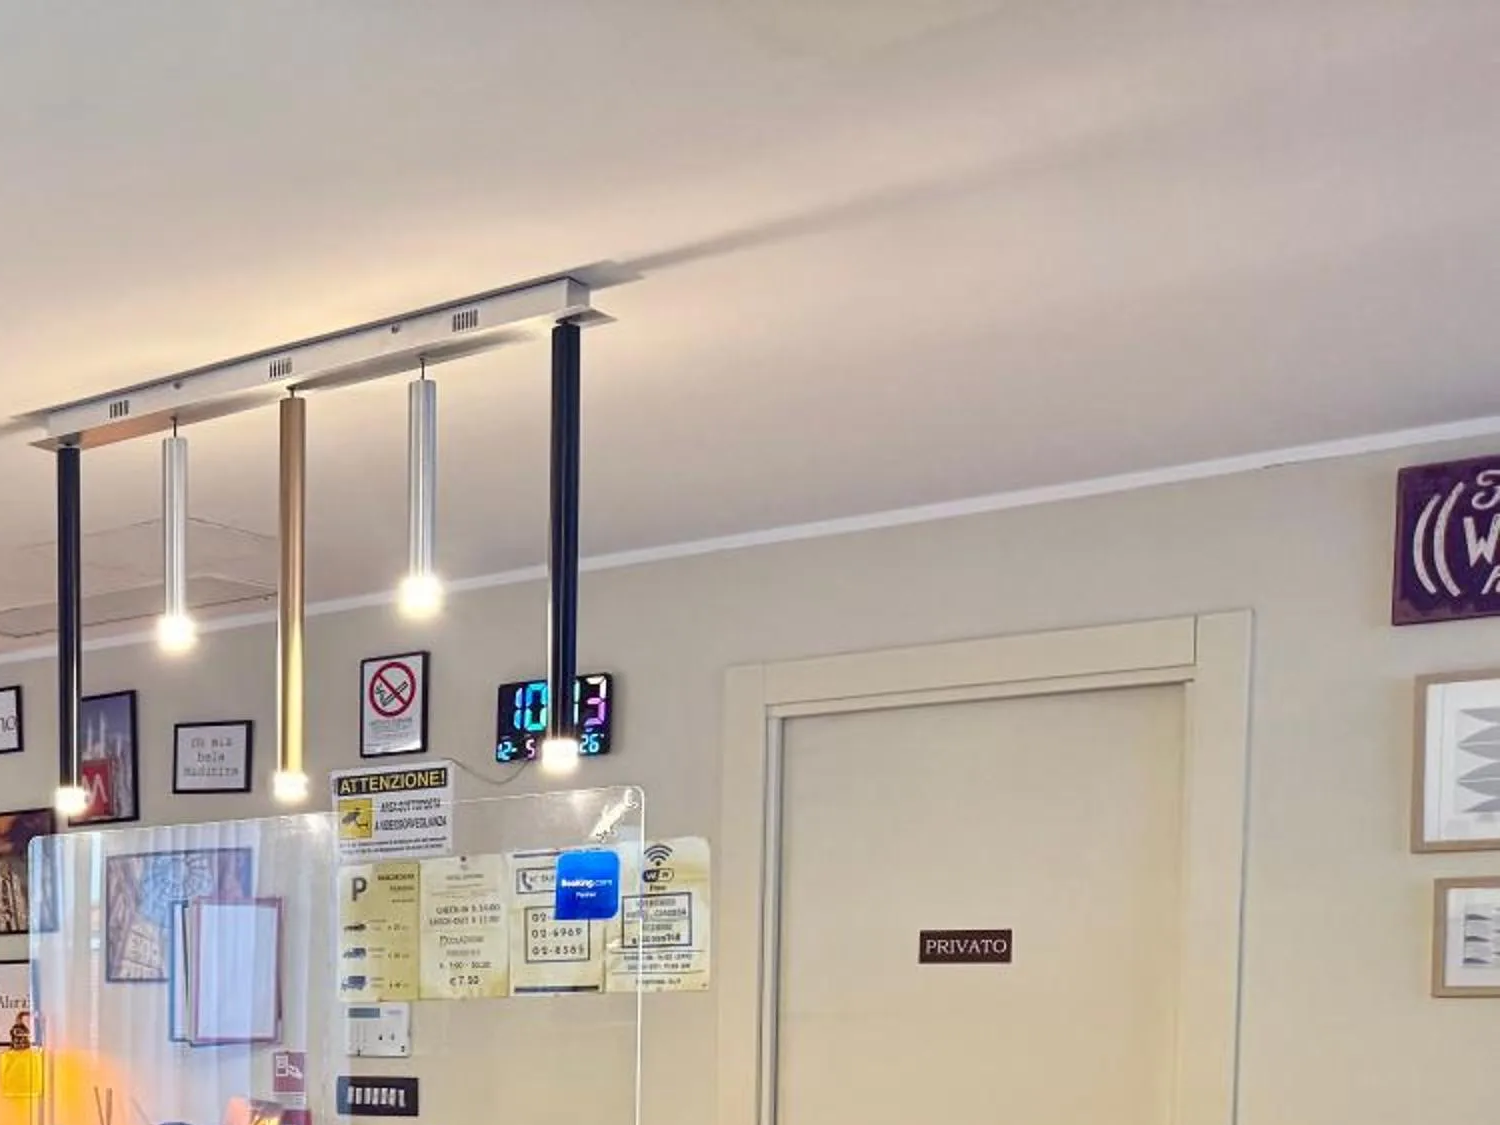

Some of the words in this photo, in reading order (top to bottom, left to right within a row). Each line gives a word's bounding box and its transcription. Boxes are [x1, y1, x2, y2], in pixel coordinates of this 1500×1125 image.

[340, 769, 445, 794] ATTENZIONE!
[351, 876, 368, 902] P
[925, 938, 1008, 954] PRIVATO
